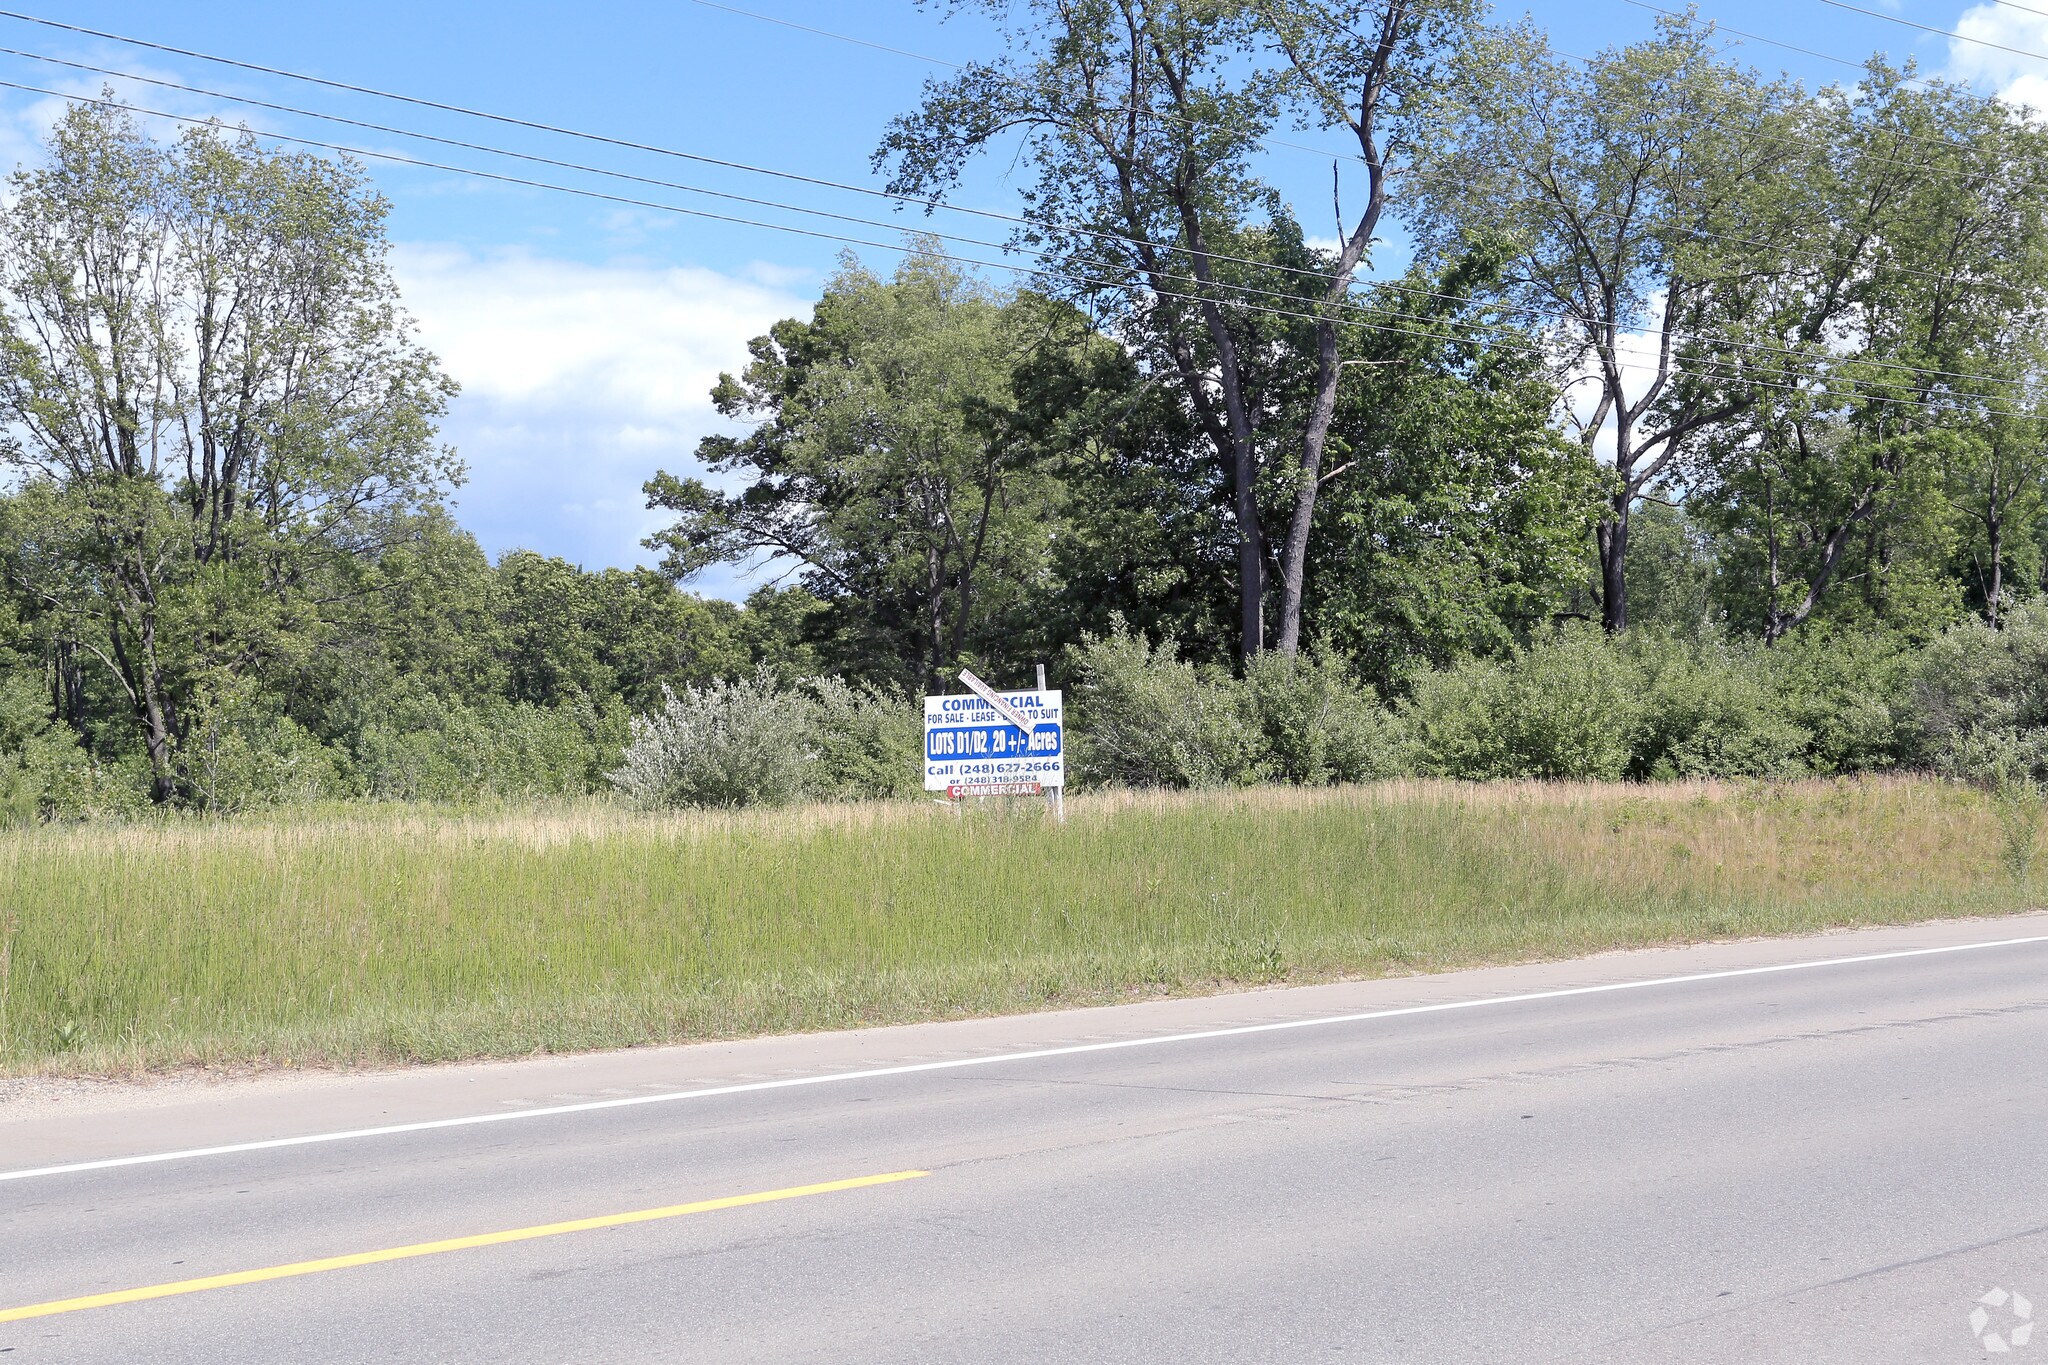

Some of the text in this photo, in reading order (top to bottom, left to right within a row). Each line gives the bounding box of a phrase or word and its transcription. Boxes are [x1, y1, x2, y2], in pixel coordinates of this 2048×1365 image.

[962, 670, 988, 692] AVAILABLE
[942, 696, 1044, 711] COMMCIAL
[988, 690, 1012, 712] FINANCING
[928, 714, 942, 724] FOR
[945, 712, 964, 723] SALE
[971, 711, 995, 722] LEASE
[1028, 710, 1040, 720] TO
[1041, 708, 1059, 719] SUIT
[1011, 709, 1029, 725] OWNER
[930, 732, 954, 755] LOTS
[957, 731, 987, 756] D1/D2
[993, 730, 1006, 752] 20
[1028, 731, 1058, 751] Acres
[928, 764, 953, 775] Call
[952, 784, 1036, 796] COMMERCIAL
